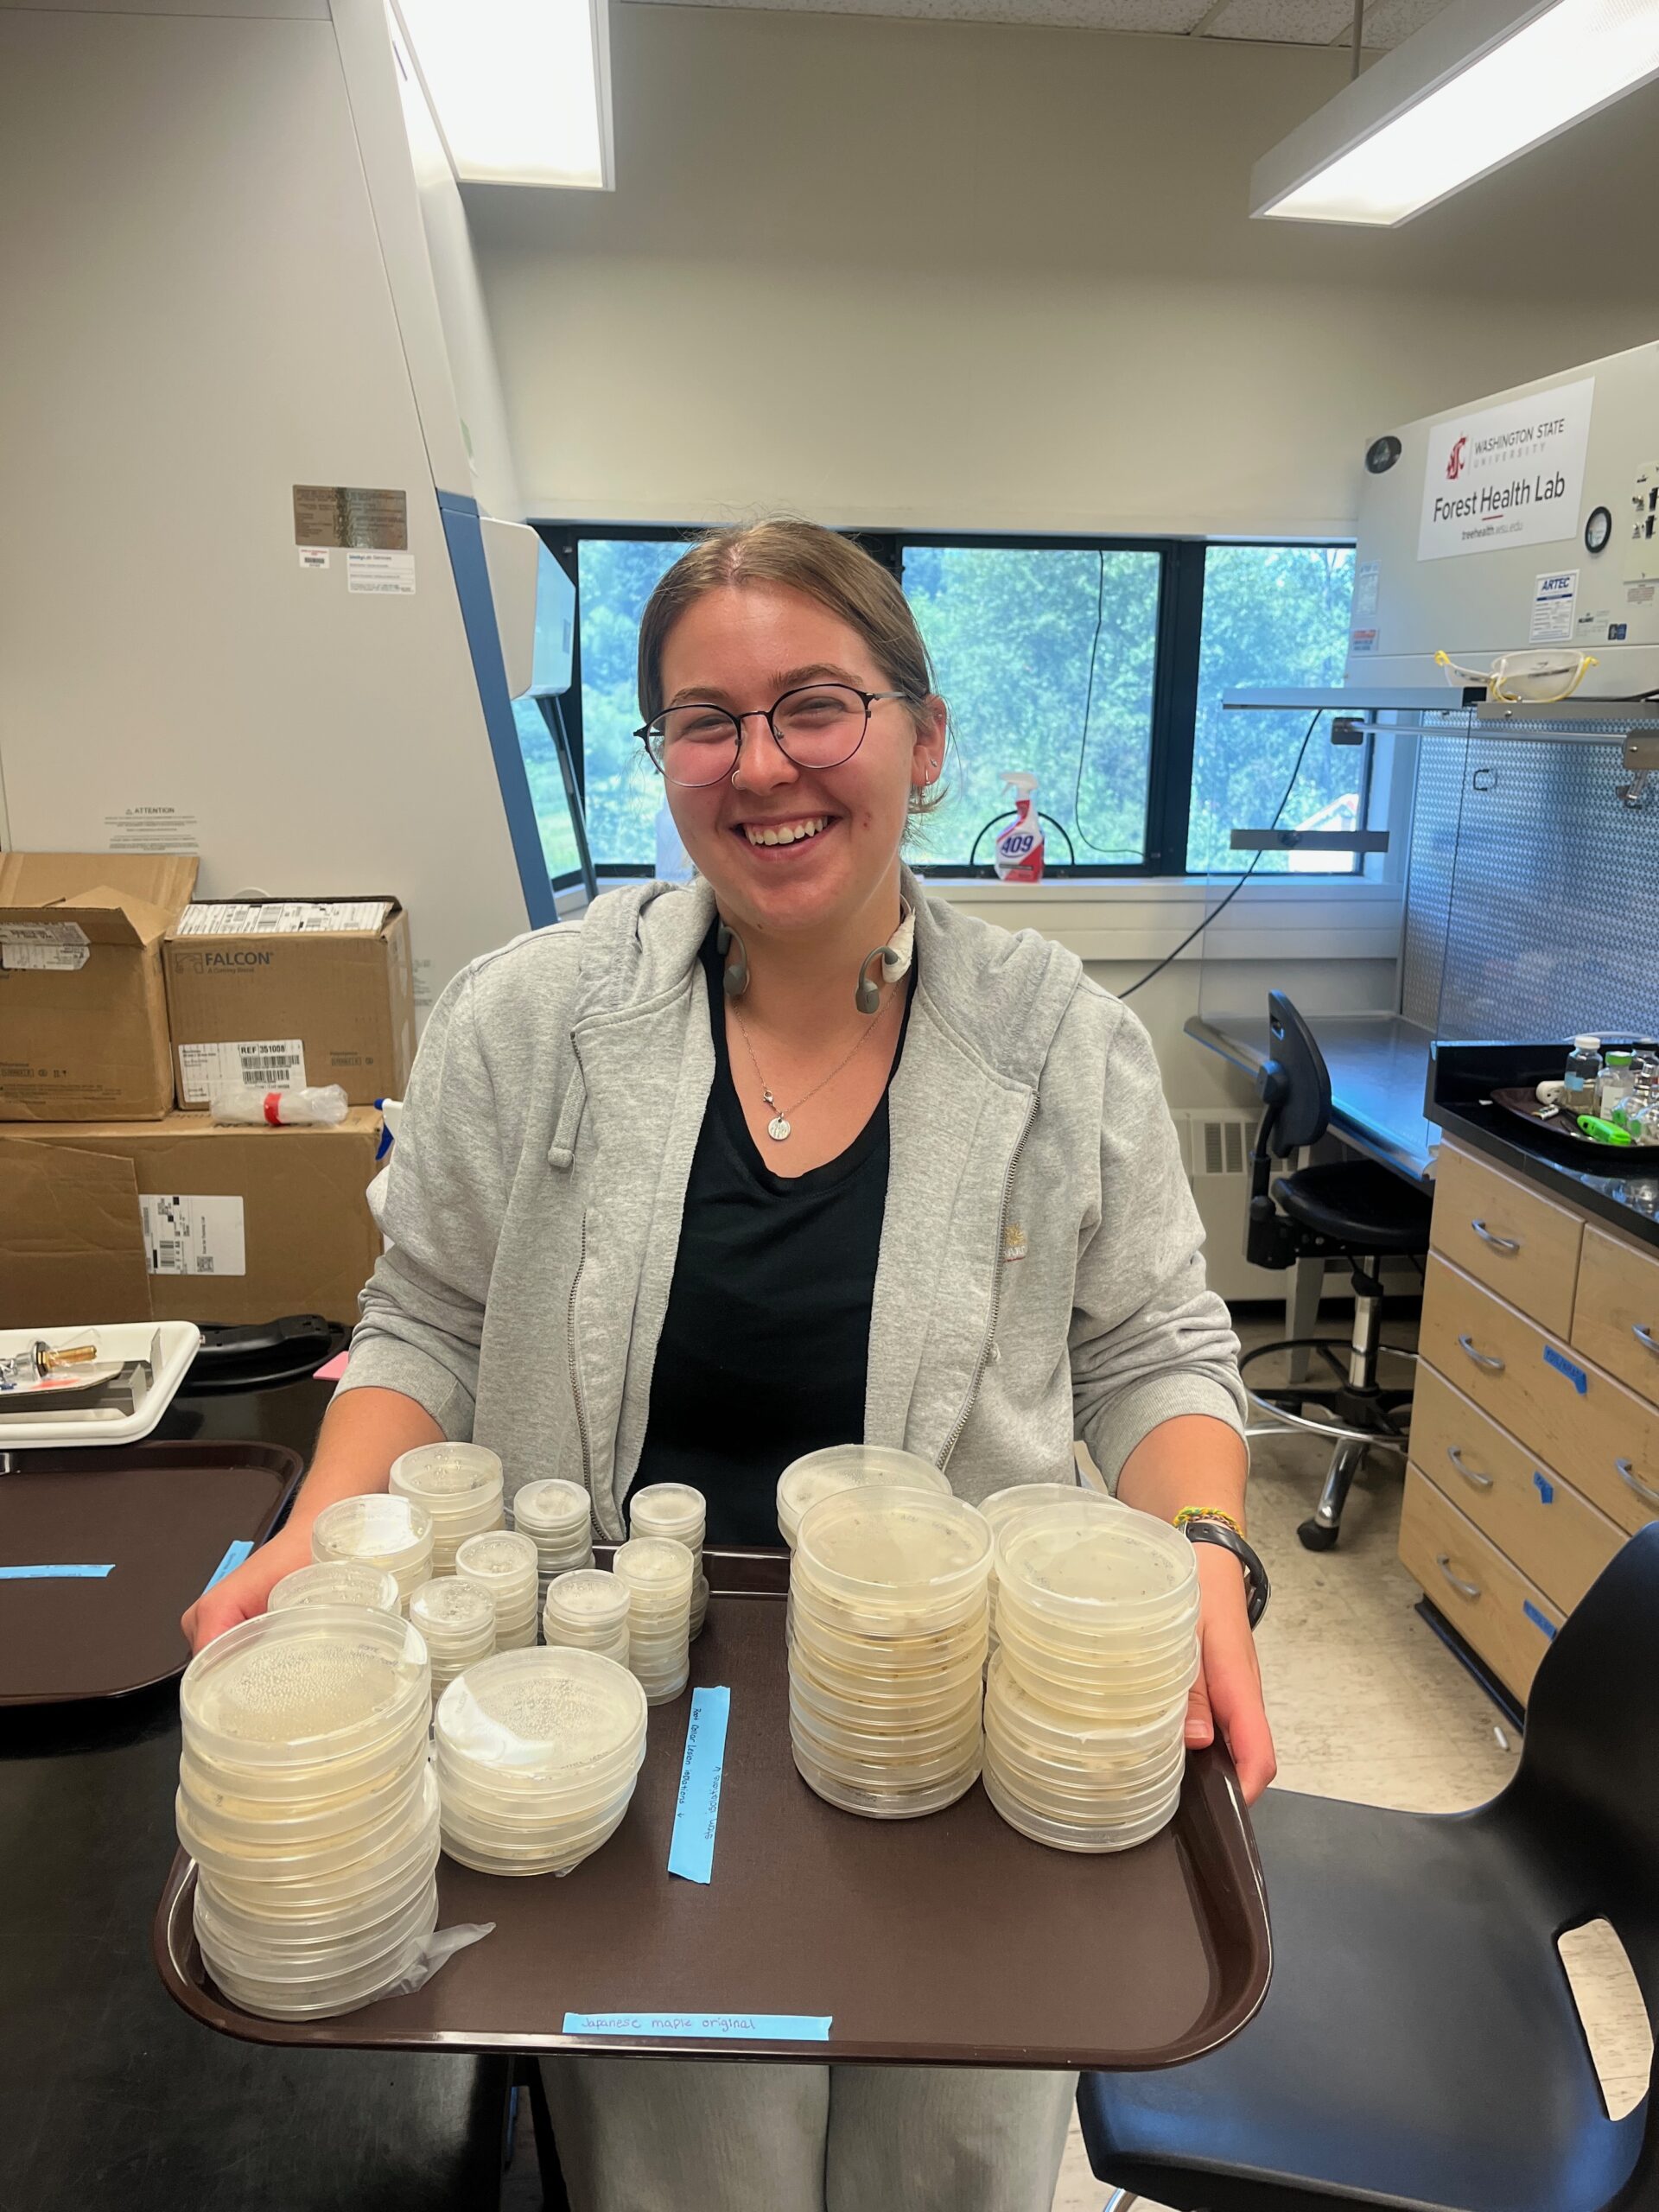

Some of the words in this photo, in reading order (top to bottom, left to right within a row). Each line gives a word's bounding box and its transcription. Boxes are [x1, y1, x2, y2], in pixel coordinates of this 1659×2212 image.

[1474, 426, 1535, 454] WASHINGTON
[1536, 418, 1566, 439] STATE
[1473, 442, 1546, 468] UNIVERSITY
[1433, 491, 1478, 523] Forest
[1480, 479, 1531, 513] Health
[1535, 471, 1566, 502] Lab
[1541, 577, 1571, 591] ARTEC
[205, 951, 270, 966] FALCON
[685, 1745, 697, 1765] Lesion
[652, 2018, 692, 2031] maple
[702, 2017, 756, 2031] original
